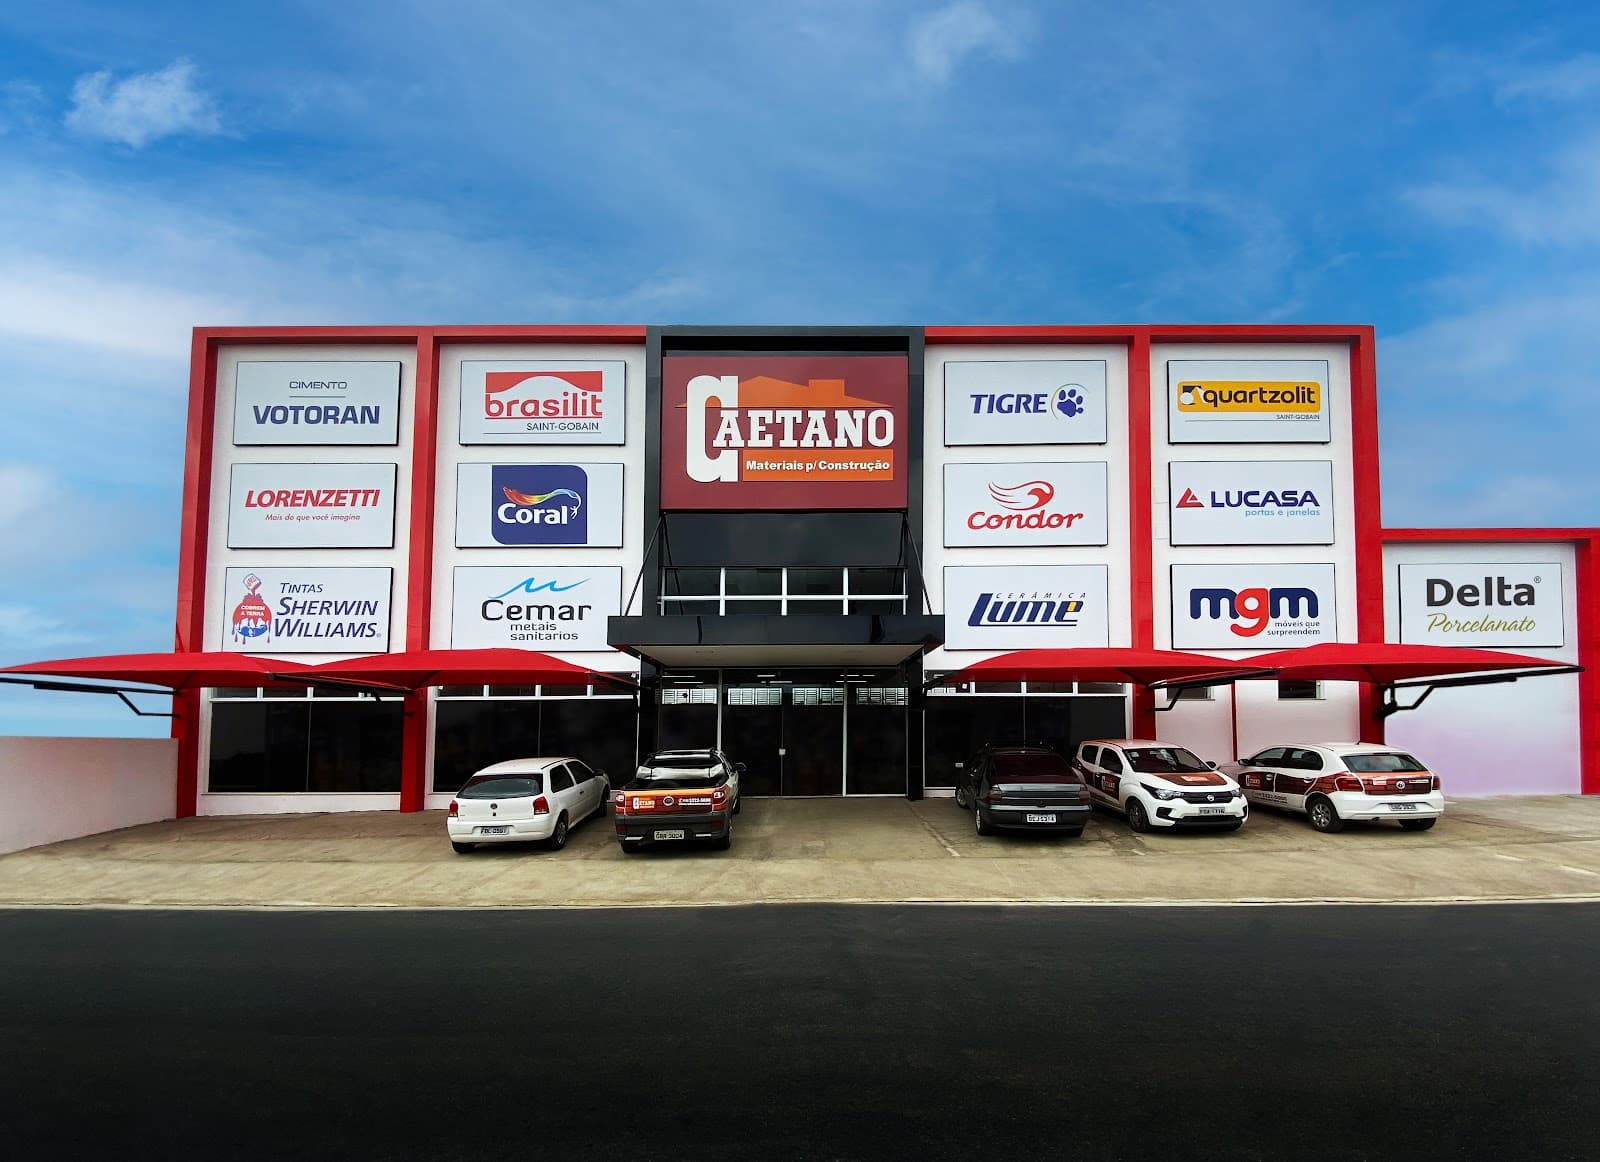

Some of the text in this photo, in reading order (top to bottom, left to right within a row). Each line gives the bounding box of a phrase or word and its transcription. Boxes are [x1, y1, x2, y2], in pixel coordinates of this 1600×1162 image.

[289, 381, 348, 390] CIMENTO
[484, 391, 603, 417] brasilit
[969, 393, 1049, 414] TIGRE
[1203, 386, 1316, 408] quartzolit
[252, 405, 381, 425] VOTORAN
[526, 422, 599, 431] SAINT-GOBAIN
[686, 375, 895, 483] CAETANO
[745, 459, 890, 473] Materiais p/ Construção
[244, 489, 381, 508] LORENZETTI
[1210, 490, 1321, 508] LUCASA
[265, 513, 361, 523] Mais do que você imagina
[497, 503, 568, 525] Coral
[967, 509, 1084, 530] Condor
[1245, 509, 1275, 517] portas
[1286, 508, 1321, 518] janelas
[280, 582, 324, 594] TINTAS
[276, 596, 379, 616] SHERWIN
[481, 599, 592, 621] Cemar
[1189, 587, 1319, 637] mgm
[510, 622, 557, 631] metais
[1274, 620, 1321, 629] móveis que
[1426, 612, 1536, 633] Porcelanato
[510, 631, 579, 641] sanitarios
[1266, 628, 1321, 637] surpreendem
